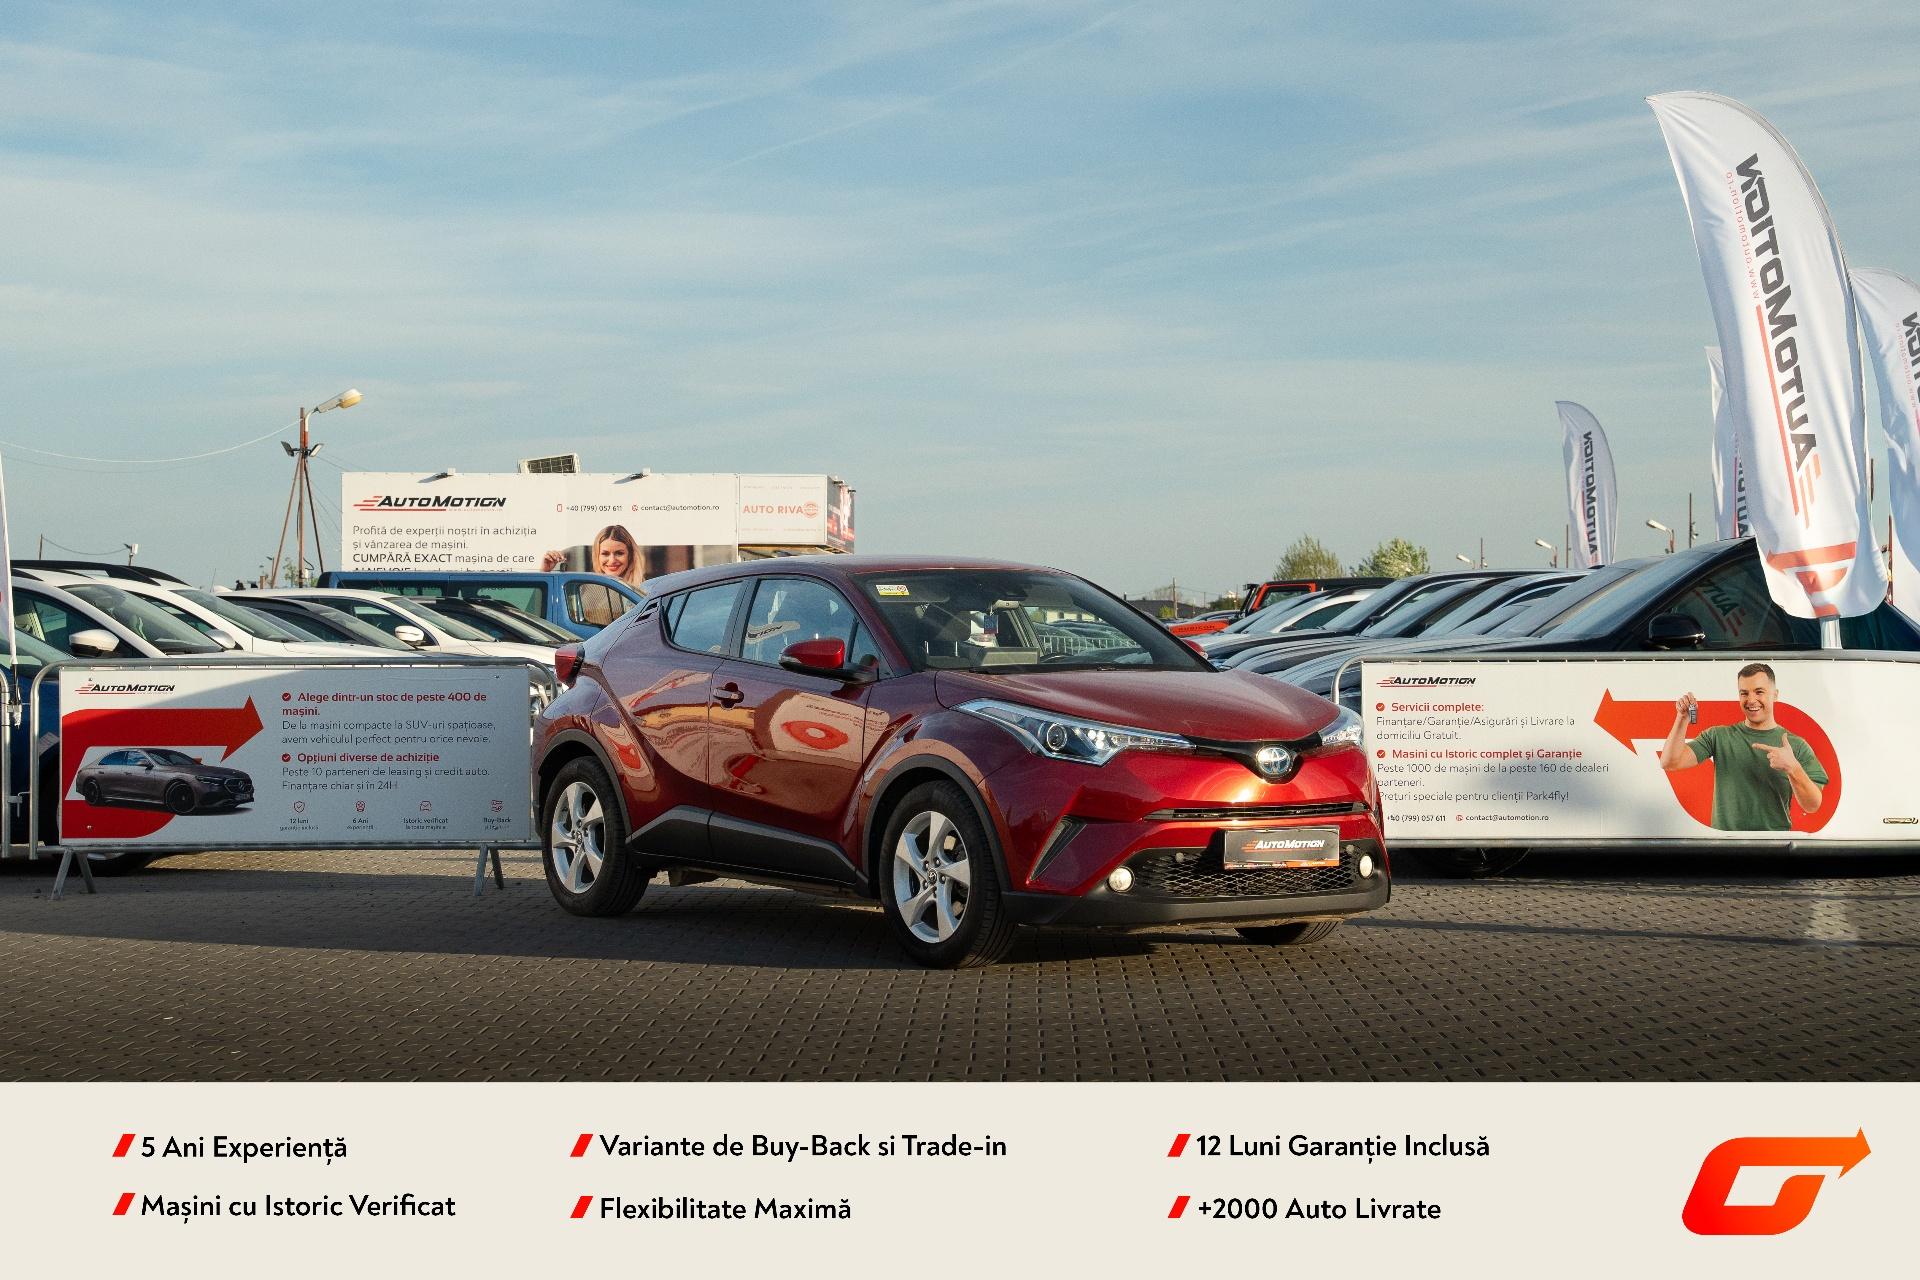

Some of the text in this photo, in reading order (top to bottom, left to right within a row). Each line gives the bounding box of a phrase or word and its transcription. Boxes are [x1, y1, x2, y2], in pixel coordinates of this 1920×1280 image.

[581, 503, 597, 513] (799)
[599, 504, 611, 512] 057
[640, 503, 720, 513] contact@automotion.ro
[743, 505, 803, 514] AUTO RIVA
[353, 525, 387, 535] Profită
[390, 526, 403, 535] de
[405, 526, 445, 537] experții
[447, 526, 478, 537] noștri
[493, 526, 537, 536] achiziția
[353, 541, 361, 551] și
[415, 540, 428, 549] de
[353, 551, 535, 565] CUMPĂRĂ EXACT mașina de care
[298, 692, 487, 704] Alege dintr-un stoc de peste 400 de
[282, 706, 320, 718] mașini.
[1391, 702, 1484, 714] Servicii complete:
[282, 720, 496, 733] De la mașini compacte la SUV-uri spațioase,
[1520, 716, 1528, 728] și
[1531, 716, 1564, 726] Livrare
[1566, 716, 1574, 726] la
[283, 734, 491, 747] avem vehiculul perfect pentru orice nevoie.
[1376, 730, 1462, 740] domiciliu Gratuit.
[297, 752, 440, 764] Opțiuni diverse de achiziție
[1430, 751, 1442, 759] cu
[1445, 748, 1478, 759] Istoric
[1480, 748, 1523, 761] complet
[1526, 749, 1534, 761] și
[1537, 748, 1582, 761] Garanție
[282, 766, 490, 779] Peste 10 parteneri de leasing și credit auto.
[1377, 762, 1609, 775] Peste 1000 de mașini de la peste 160 de dealeri
[282, 781, 328, 792] Finanțare
[330, 780, 354, 791] chiar
[356, 781, 364, 792] și
[366, 780, 375, 790] în
[1413, 790, 1453, 803] speciale
[1455, 792, 1489, 803] pentru
[1491, 790, 1524, 803] clienții
[1526, 790, 1569, 803] Park4fly!
[1401, 814, 1420, 823] (799)
[1465, 813, 1549, 823] contact@automotion.ro
